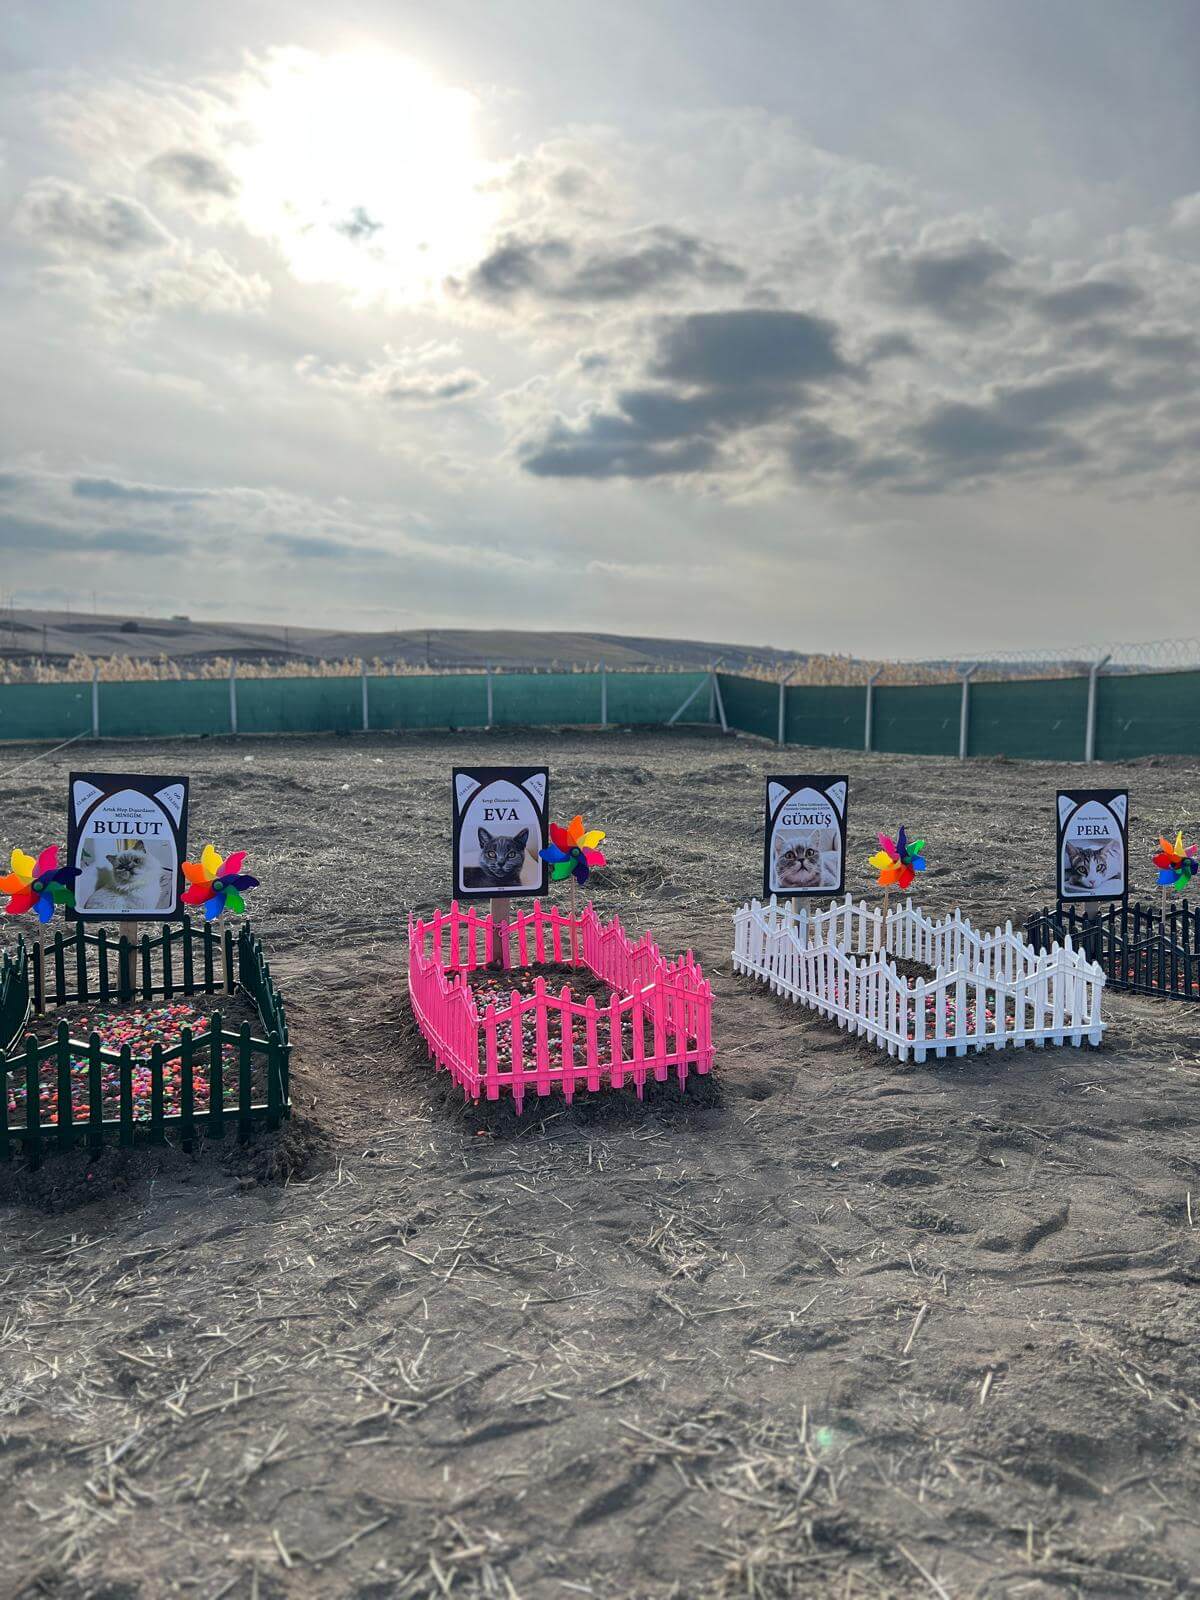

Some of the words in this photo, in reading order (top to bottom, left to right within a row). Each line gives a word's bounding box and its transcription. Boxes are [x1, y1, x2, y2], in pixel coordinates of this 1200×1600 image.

[483, 808, 520, 821] EVA
[782, 812, 832, 828] GÜMÜŞ
[93, 820, 163, 835] BULUT
[1077, 825, 1110, 836] PERA
